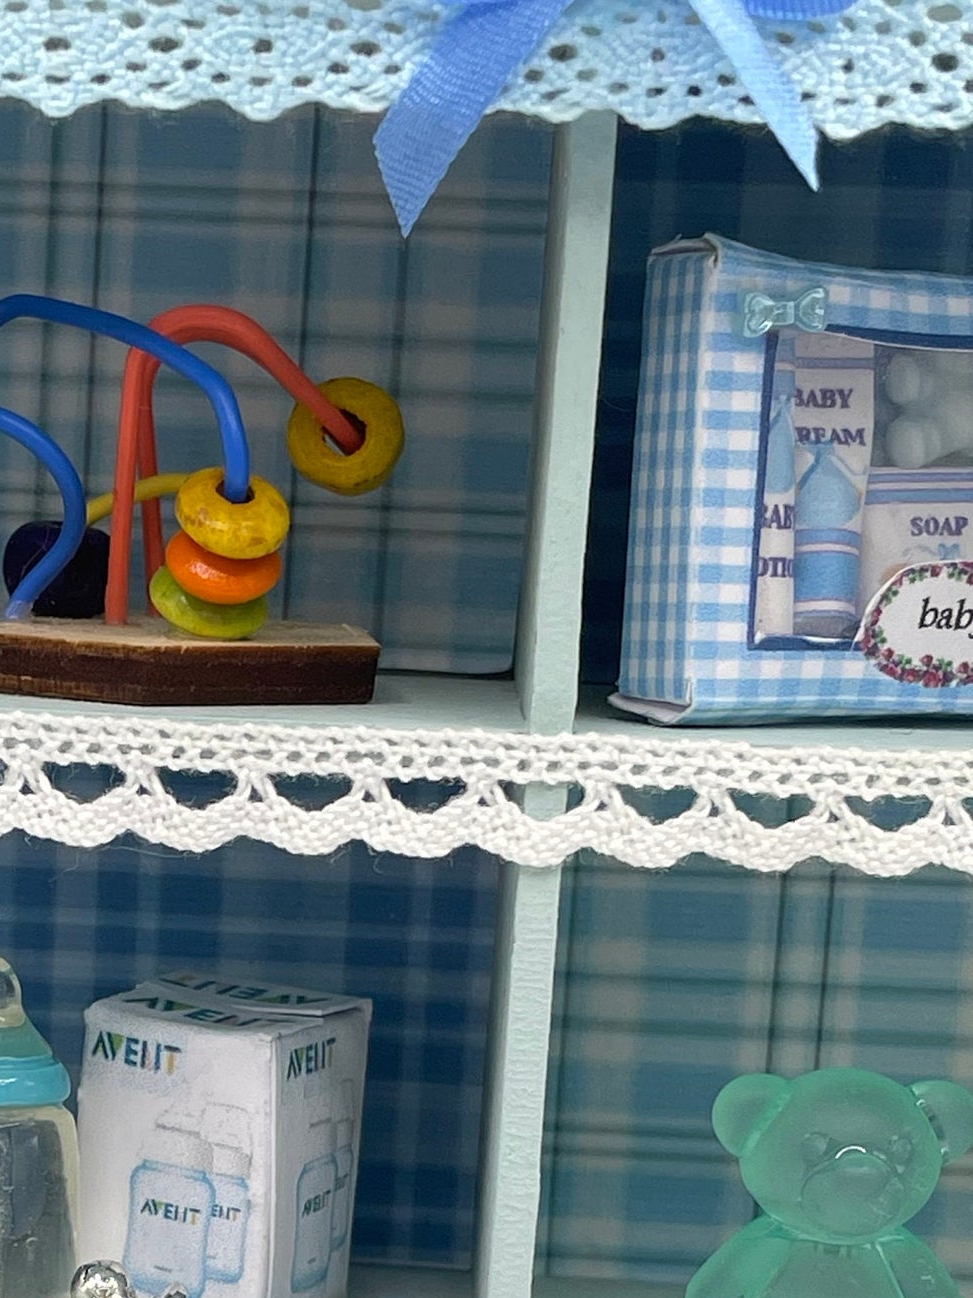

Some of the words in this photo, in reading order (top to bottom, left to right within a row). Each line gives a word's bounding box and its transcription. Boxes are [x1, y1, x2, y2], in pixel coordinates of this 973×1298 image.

[795, 426, 867, 447] REAM
[910, 516, 969, 537] SOAP
[918, 596, 973, 639] bab
